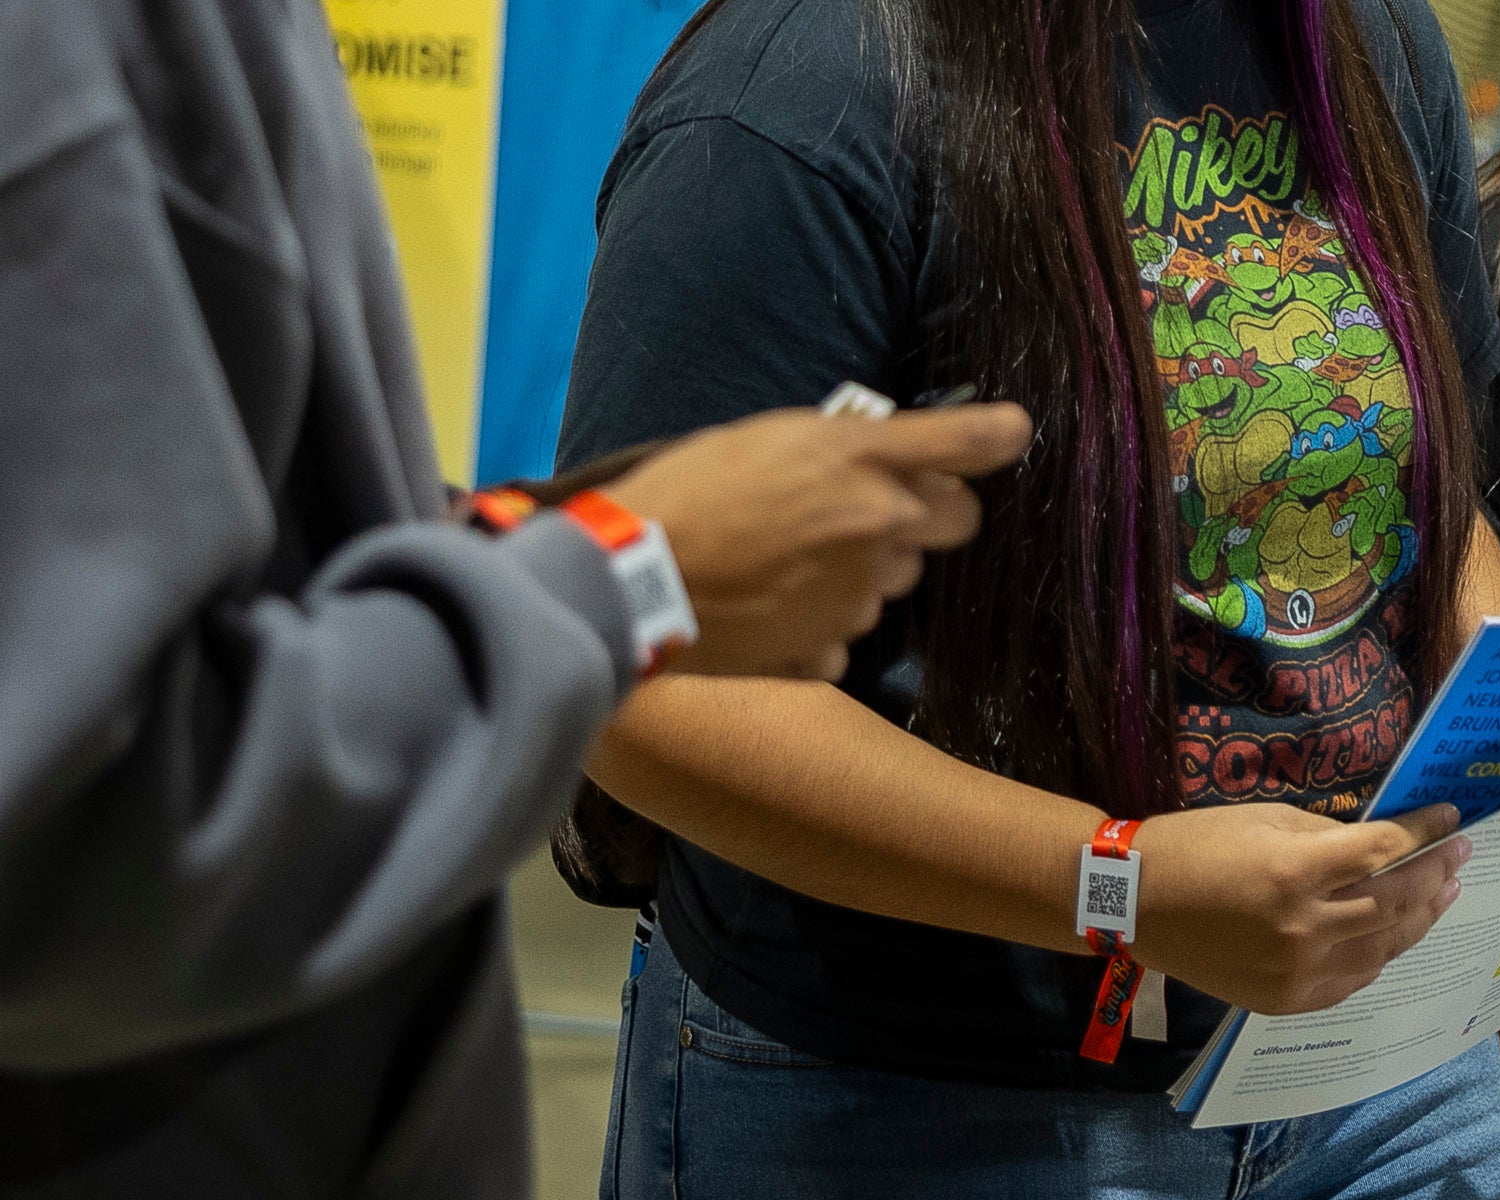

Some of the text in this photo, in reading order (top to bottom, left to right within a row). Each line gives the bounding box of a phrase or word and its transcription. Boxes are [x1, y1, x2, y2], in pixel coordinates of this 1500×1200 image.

[337, 36, 475, 84] OMISE
[1266, 637, 1382, 711] PIZZA
[1176, 696, 1409, 793] CONTEST
[1434, 740, 1474, 754] BUT
[1421, 762, 1463, 778] WILL
[1405, 784, 1449, 801] AND
[1253, 1038, 1353, 1057] California Residence
